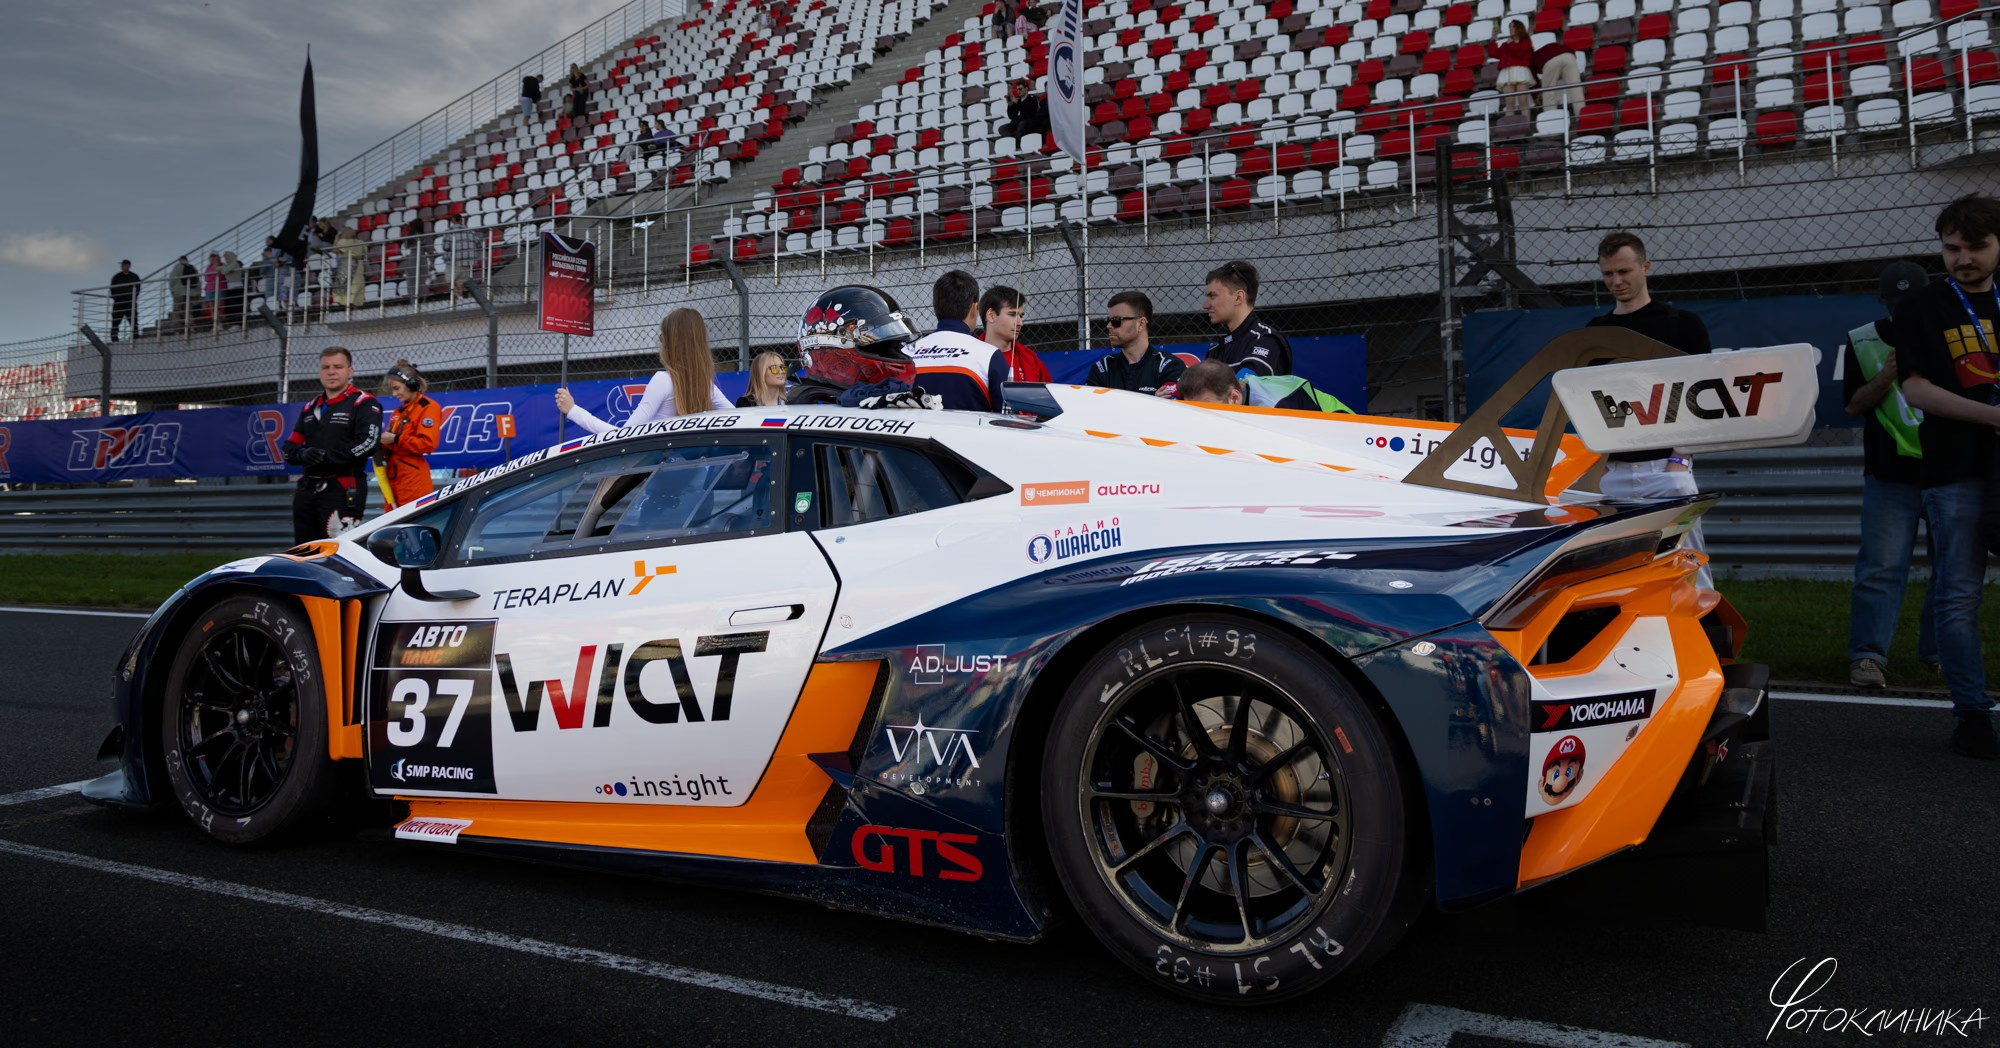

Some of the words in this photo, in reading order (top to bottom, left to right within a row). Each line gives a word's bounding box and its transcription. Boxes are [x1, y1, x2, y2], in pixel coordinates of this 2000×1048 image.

[501, 417, 511, 435] F
[582, 415, 741, 447] А.СОЛУКОВЦЕВ
[788, 414, 915, 434] Д.ПОГОСЯН
[438, 448, 545, 499] В.ВЛАДЫКИН
[1036, 487, 1086, 498] ЧЕМПИОНАТ
[1097, 483, 1160, 496] auto.ru
[1054, 517, 1120, 539] РАДИО
[1055, 527, 1122, 561] ШАНСОН
[492, 578, 626, 610] TERAPLAN
[406, 625, 468, 648] АВТО
[400, 650, 445, 665] ПЛЮС
[494, 630, 770, 733] WIAT
[386, 678, 475, 748] 37
[1569, 698, 1645, 723] YOKOHAMA
[885, 713, 980, 769] VIVA
[406, 764, 430, 779] SMP
[431, 765, 474, 780] RACING
[882, 773, 981, 787] DEVELOPMENT
[632, 774, 733, 802] insight
[851, 824, 983, 883] GTS
